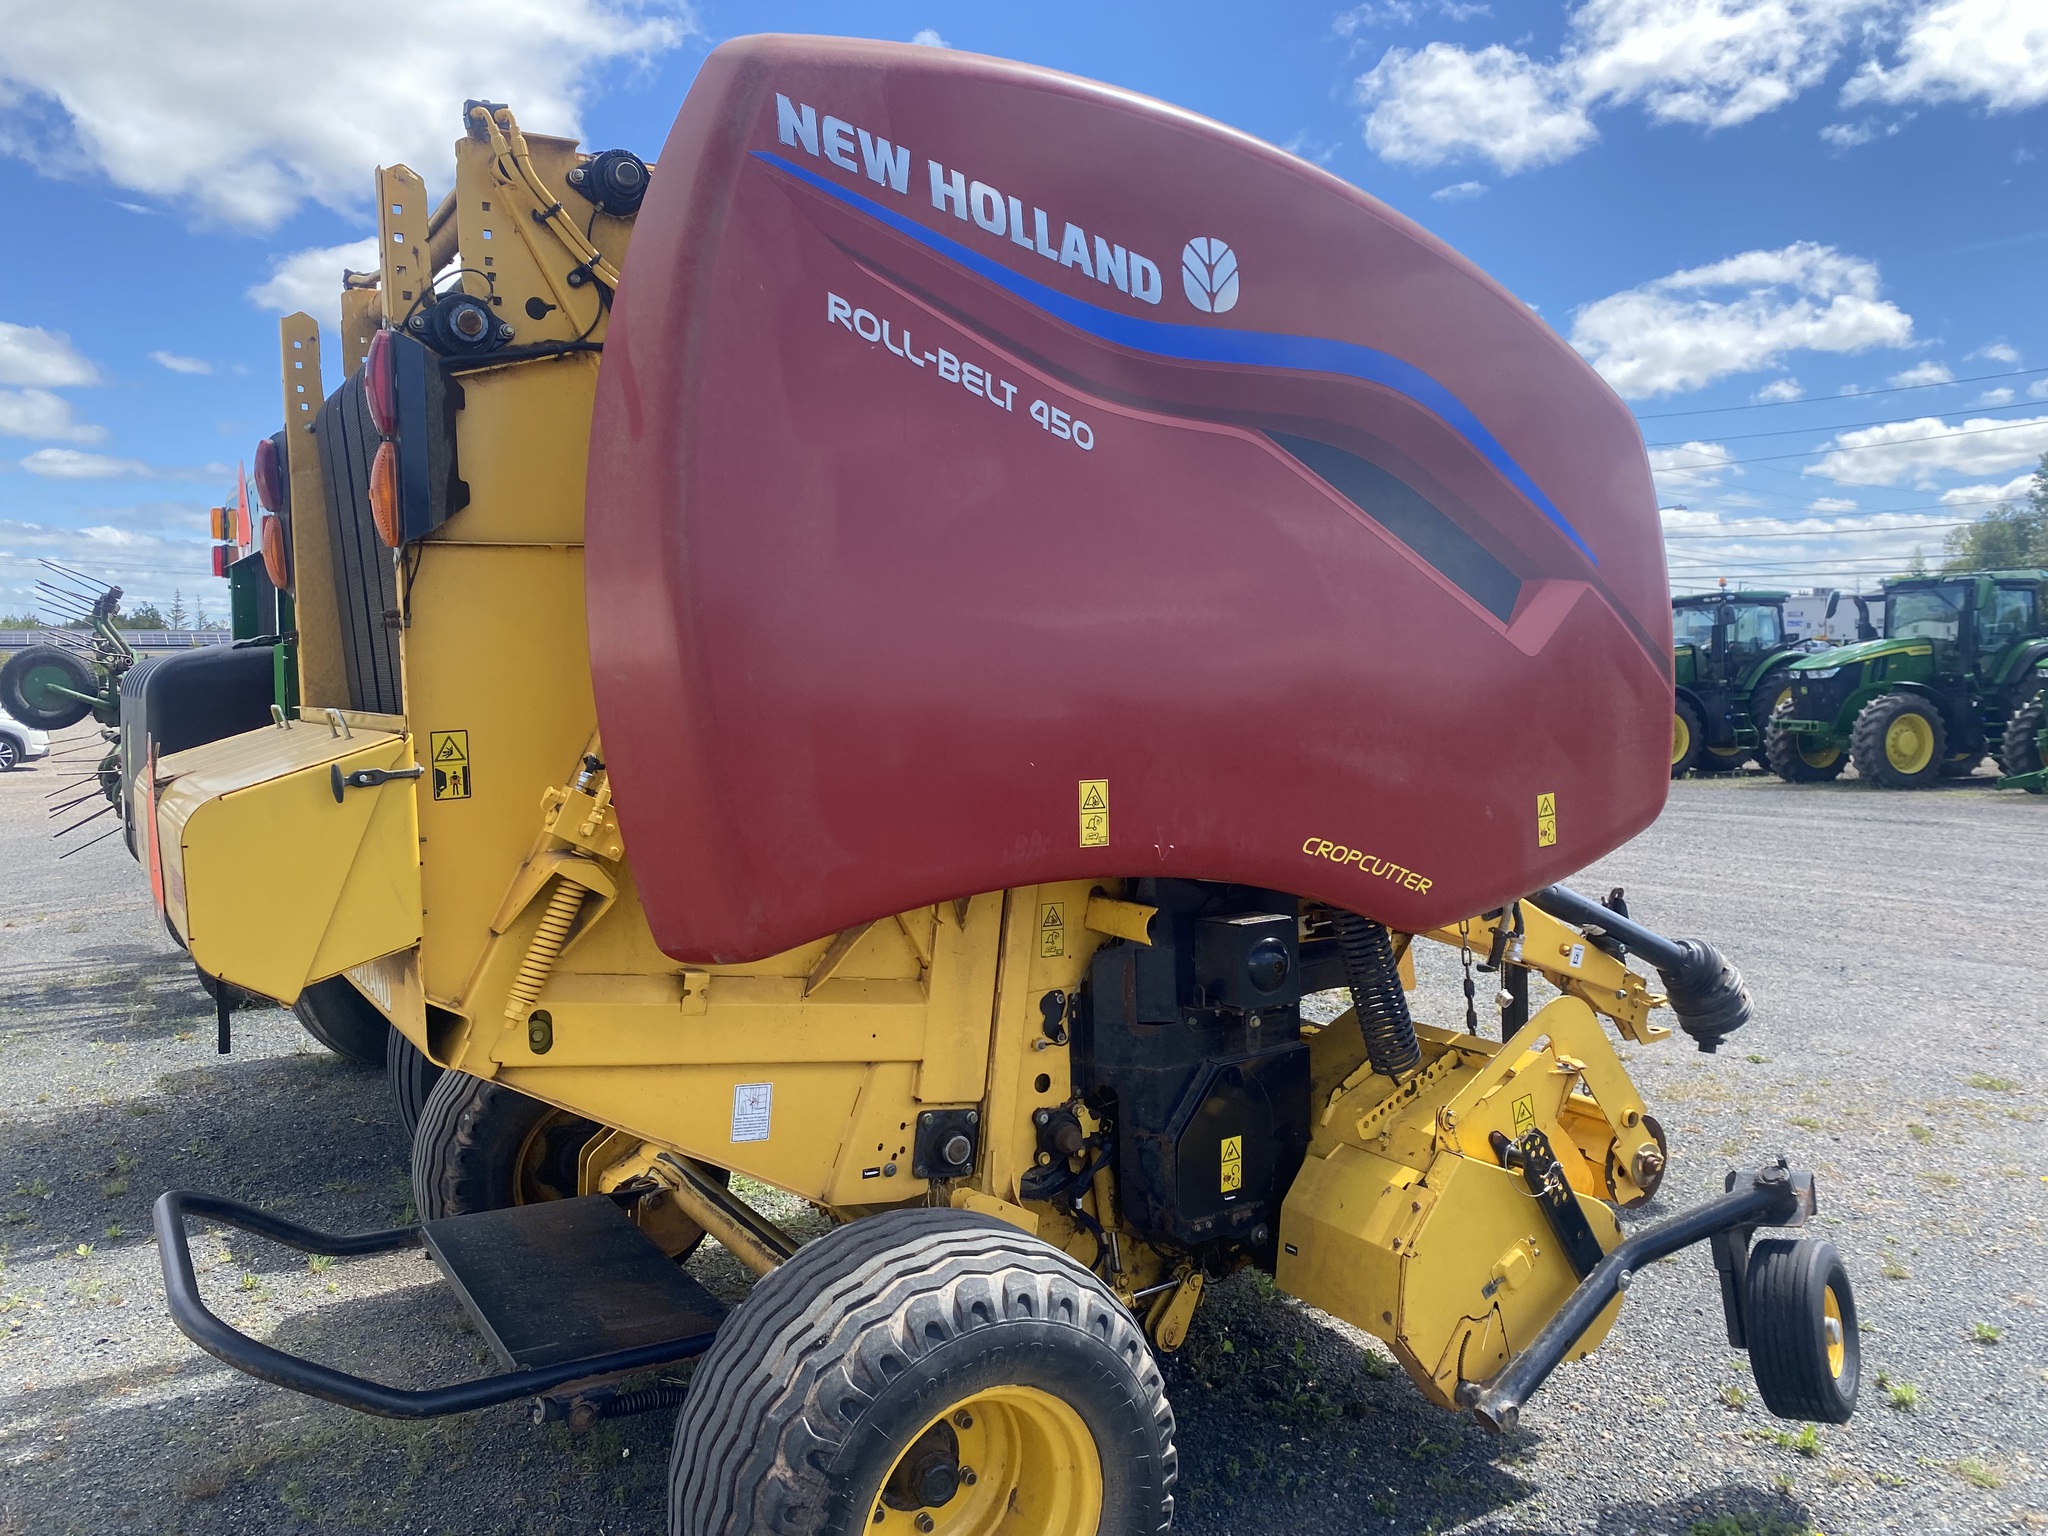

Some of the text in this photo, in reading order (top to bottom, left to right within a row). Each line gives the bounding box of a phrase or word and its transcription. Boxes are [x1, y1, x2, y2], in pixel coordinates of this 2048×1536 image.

[776, 93, 1162, 305] NEW HOLLAND
[827, 291, 1094, 451] ROLL-BELT 450
[1302, 837, 1433, 895] CROPCUTTER
